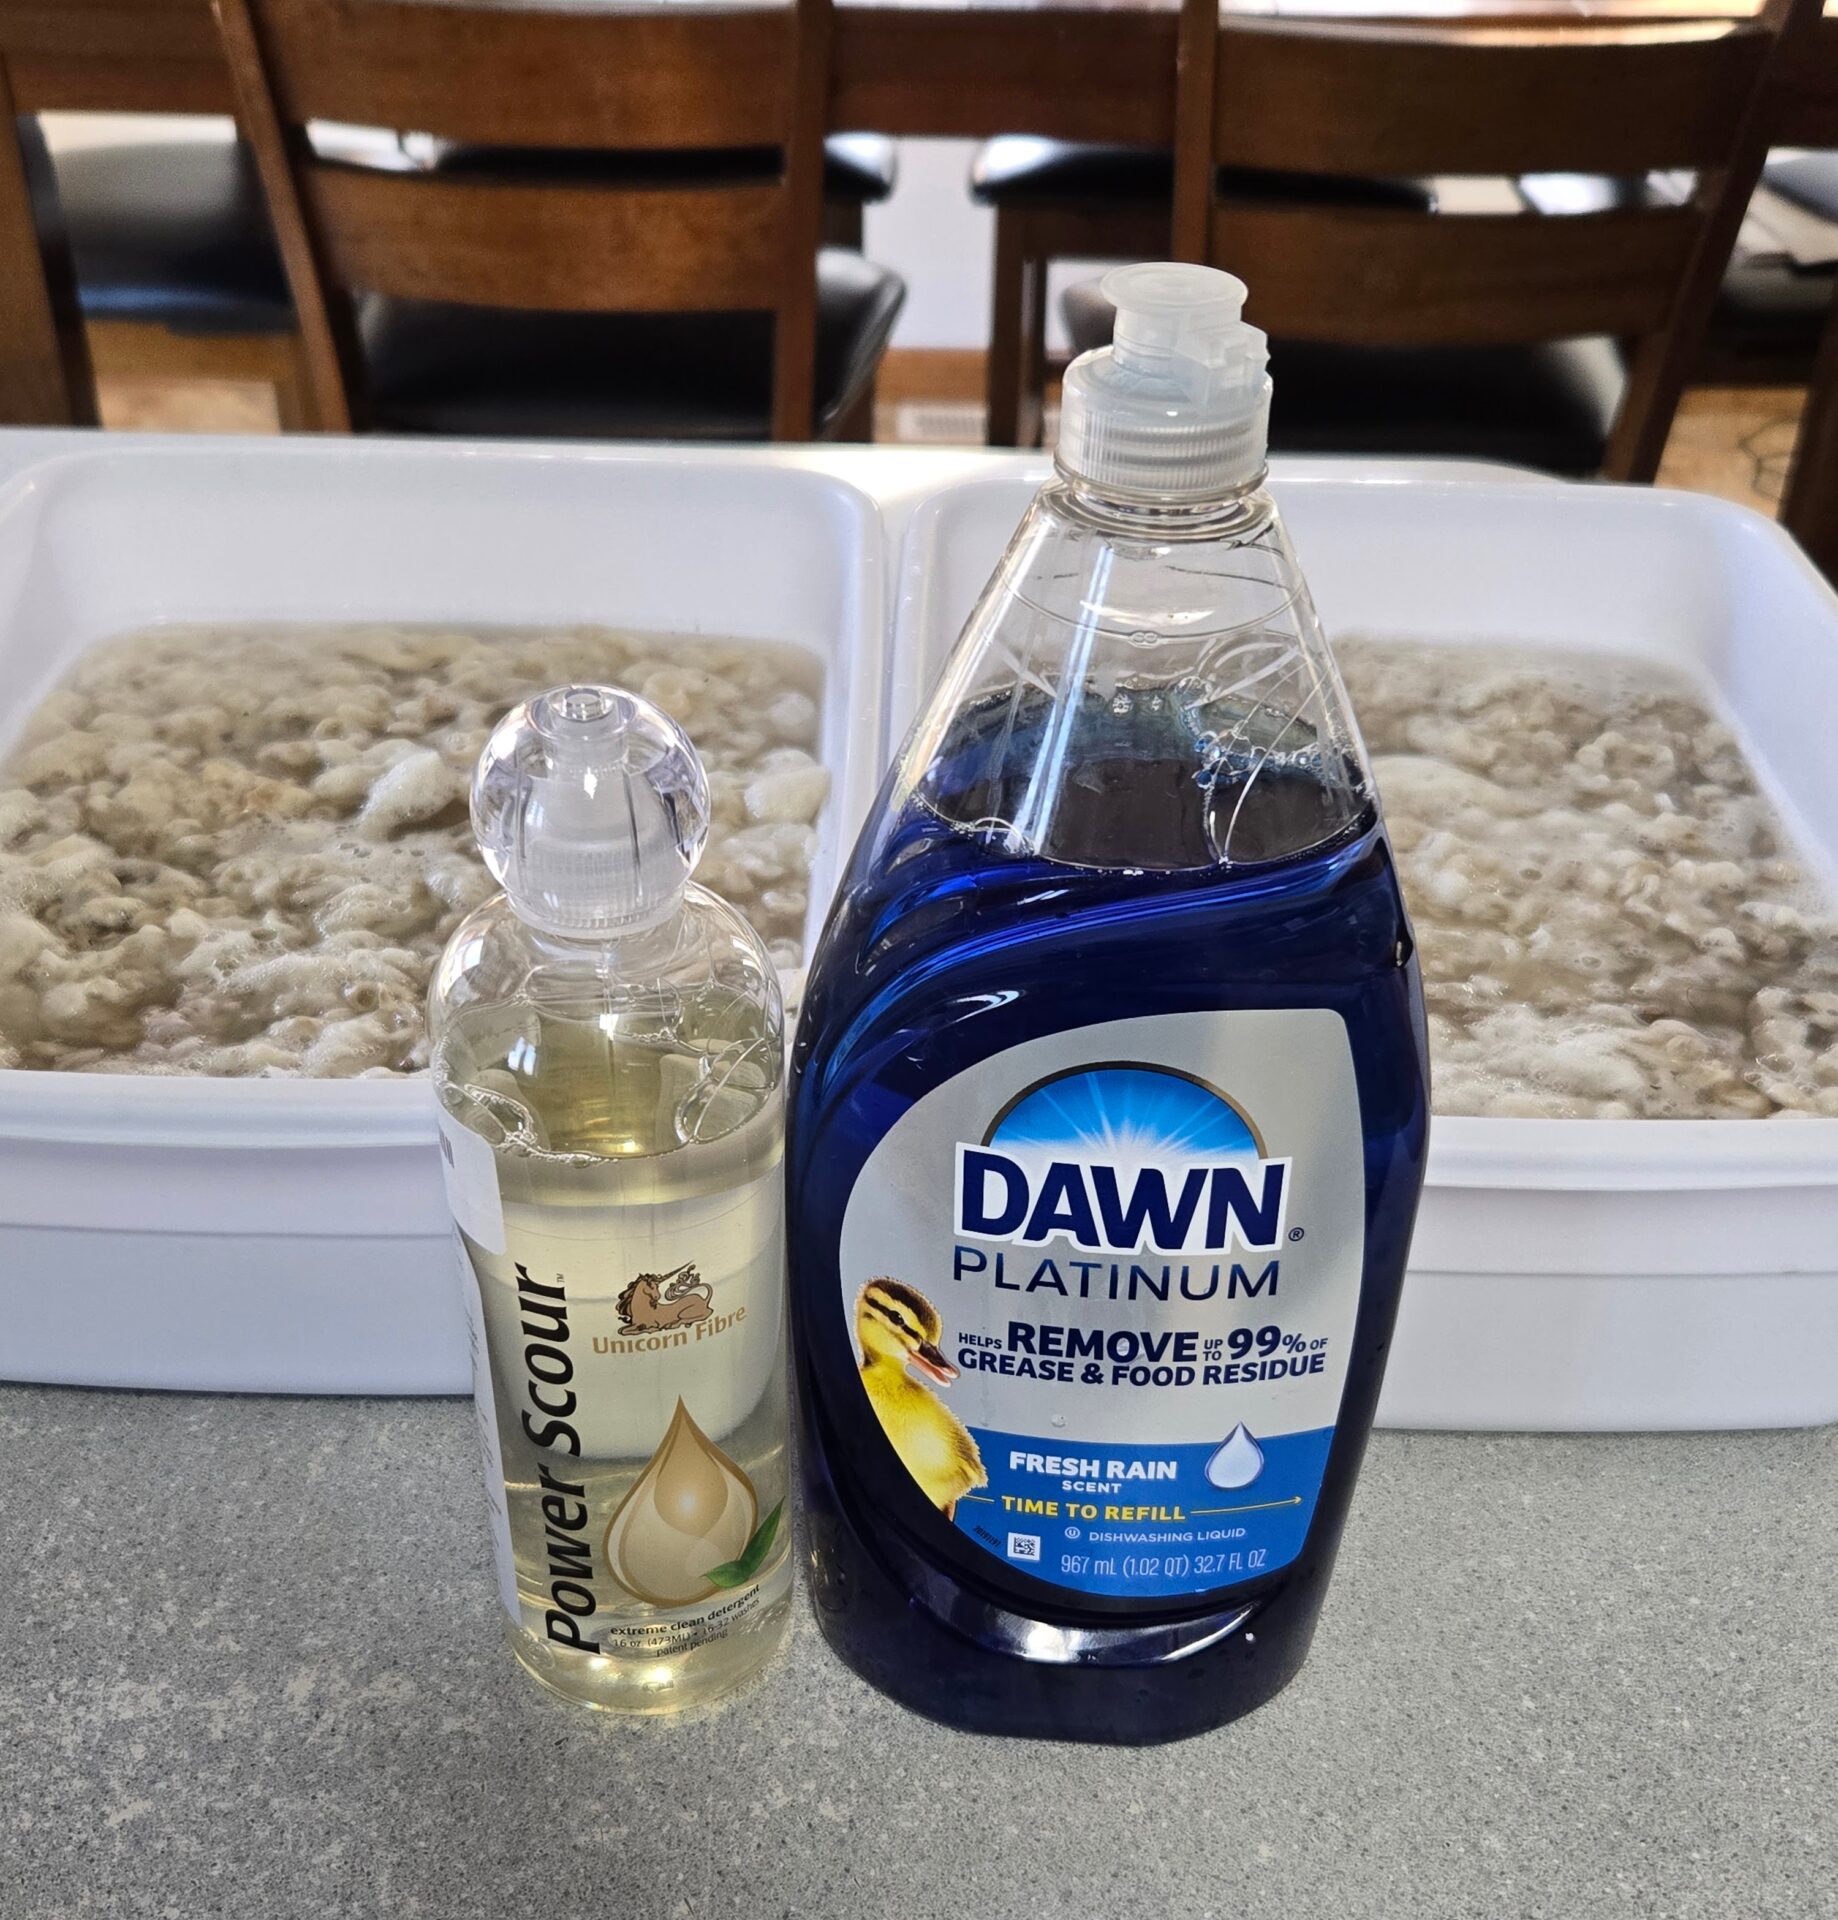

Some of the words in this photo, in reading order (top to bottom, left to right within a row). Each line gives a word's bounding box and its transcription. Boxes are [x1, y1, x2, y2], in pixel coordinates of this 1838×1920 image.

[960, 1148, 1286, 1250] DAWN
[953, 1245, 1280, 1301] PLATINUM
[592, 1330, 688, 1354] Unicorn
[695, 1306, 747, 1341] Fibre
[958, 1332, 1002, 1350] HELPS
[1007, 1321, 1199, 1363] REMOVE
[1204, 1338, 1223, 1350] UP
[1227, 1325, 1306, 1360] 99%
[1310, 1337, 1328, 1350] OF
[514, 1262, 581, 1457] Scour
[957, 1348, 1074, 1383] GREASE
[1080, 1363, 1104, 1384] &
[1112, 1365, 1195, 1387] FOOD
[1202, 1352, 1326, 1386] RESIDUE
[1203, 1350, 1222, 1361] TO
[1009, 1451, 1100, 1478] FRESH
[1106, 1460, 1177, 1479] RAIN
[1062, 1480, 1122, 1493] SCENT
[1002, 1495, 1058, 1516] TIME
[1065, 1503, 1097, 1519] TO
[1104, 1506, 1186, 1521] REFILL
[1089, 1531, 1192, 1543] DISHWASHING
[1197, 1527, 1246, 1541] LIQUID
[537, 1462, 600, 1654] Power
[1061, 1554, 1090, 1574] 967
[1094, 1557, 1117, 1576] mL
[1122, 1555, 1159, 1577] (1.02
[1164, 1554, 1189, 1577] QT)
[1194, 1554, 1225, 1574] 32.7
[1229, 1552, 1243, 1571] FL
[1248, 1549, 1267, 1568] OZ
[610, 1625, 668, 1636] extreme
[670, 1616, 705, 1632] clean
[707, 1584, 760, 1621] detergent
[613, 1638, 627, 1647] 16
[731, 1598, 760, 1622] washes
[690, 1628, 728, 1651] pending
